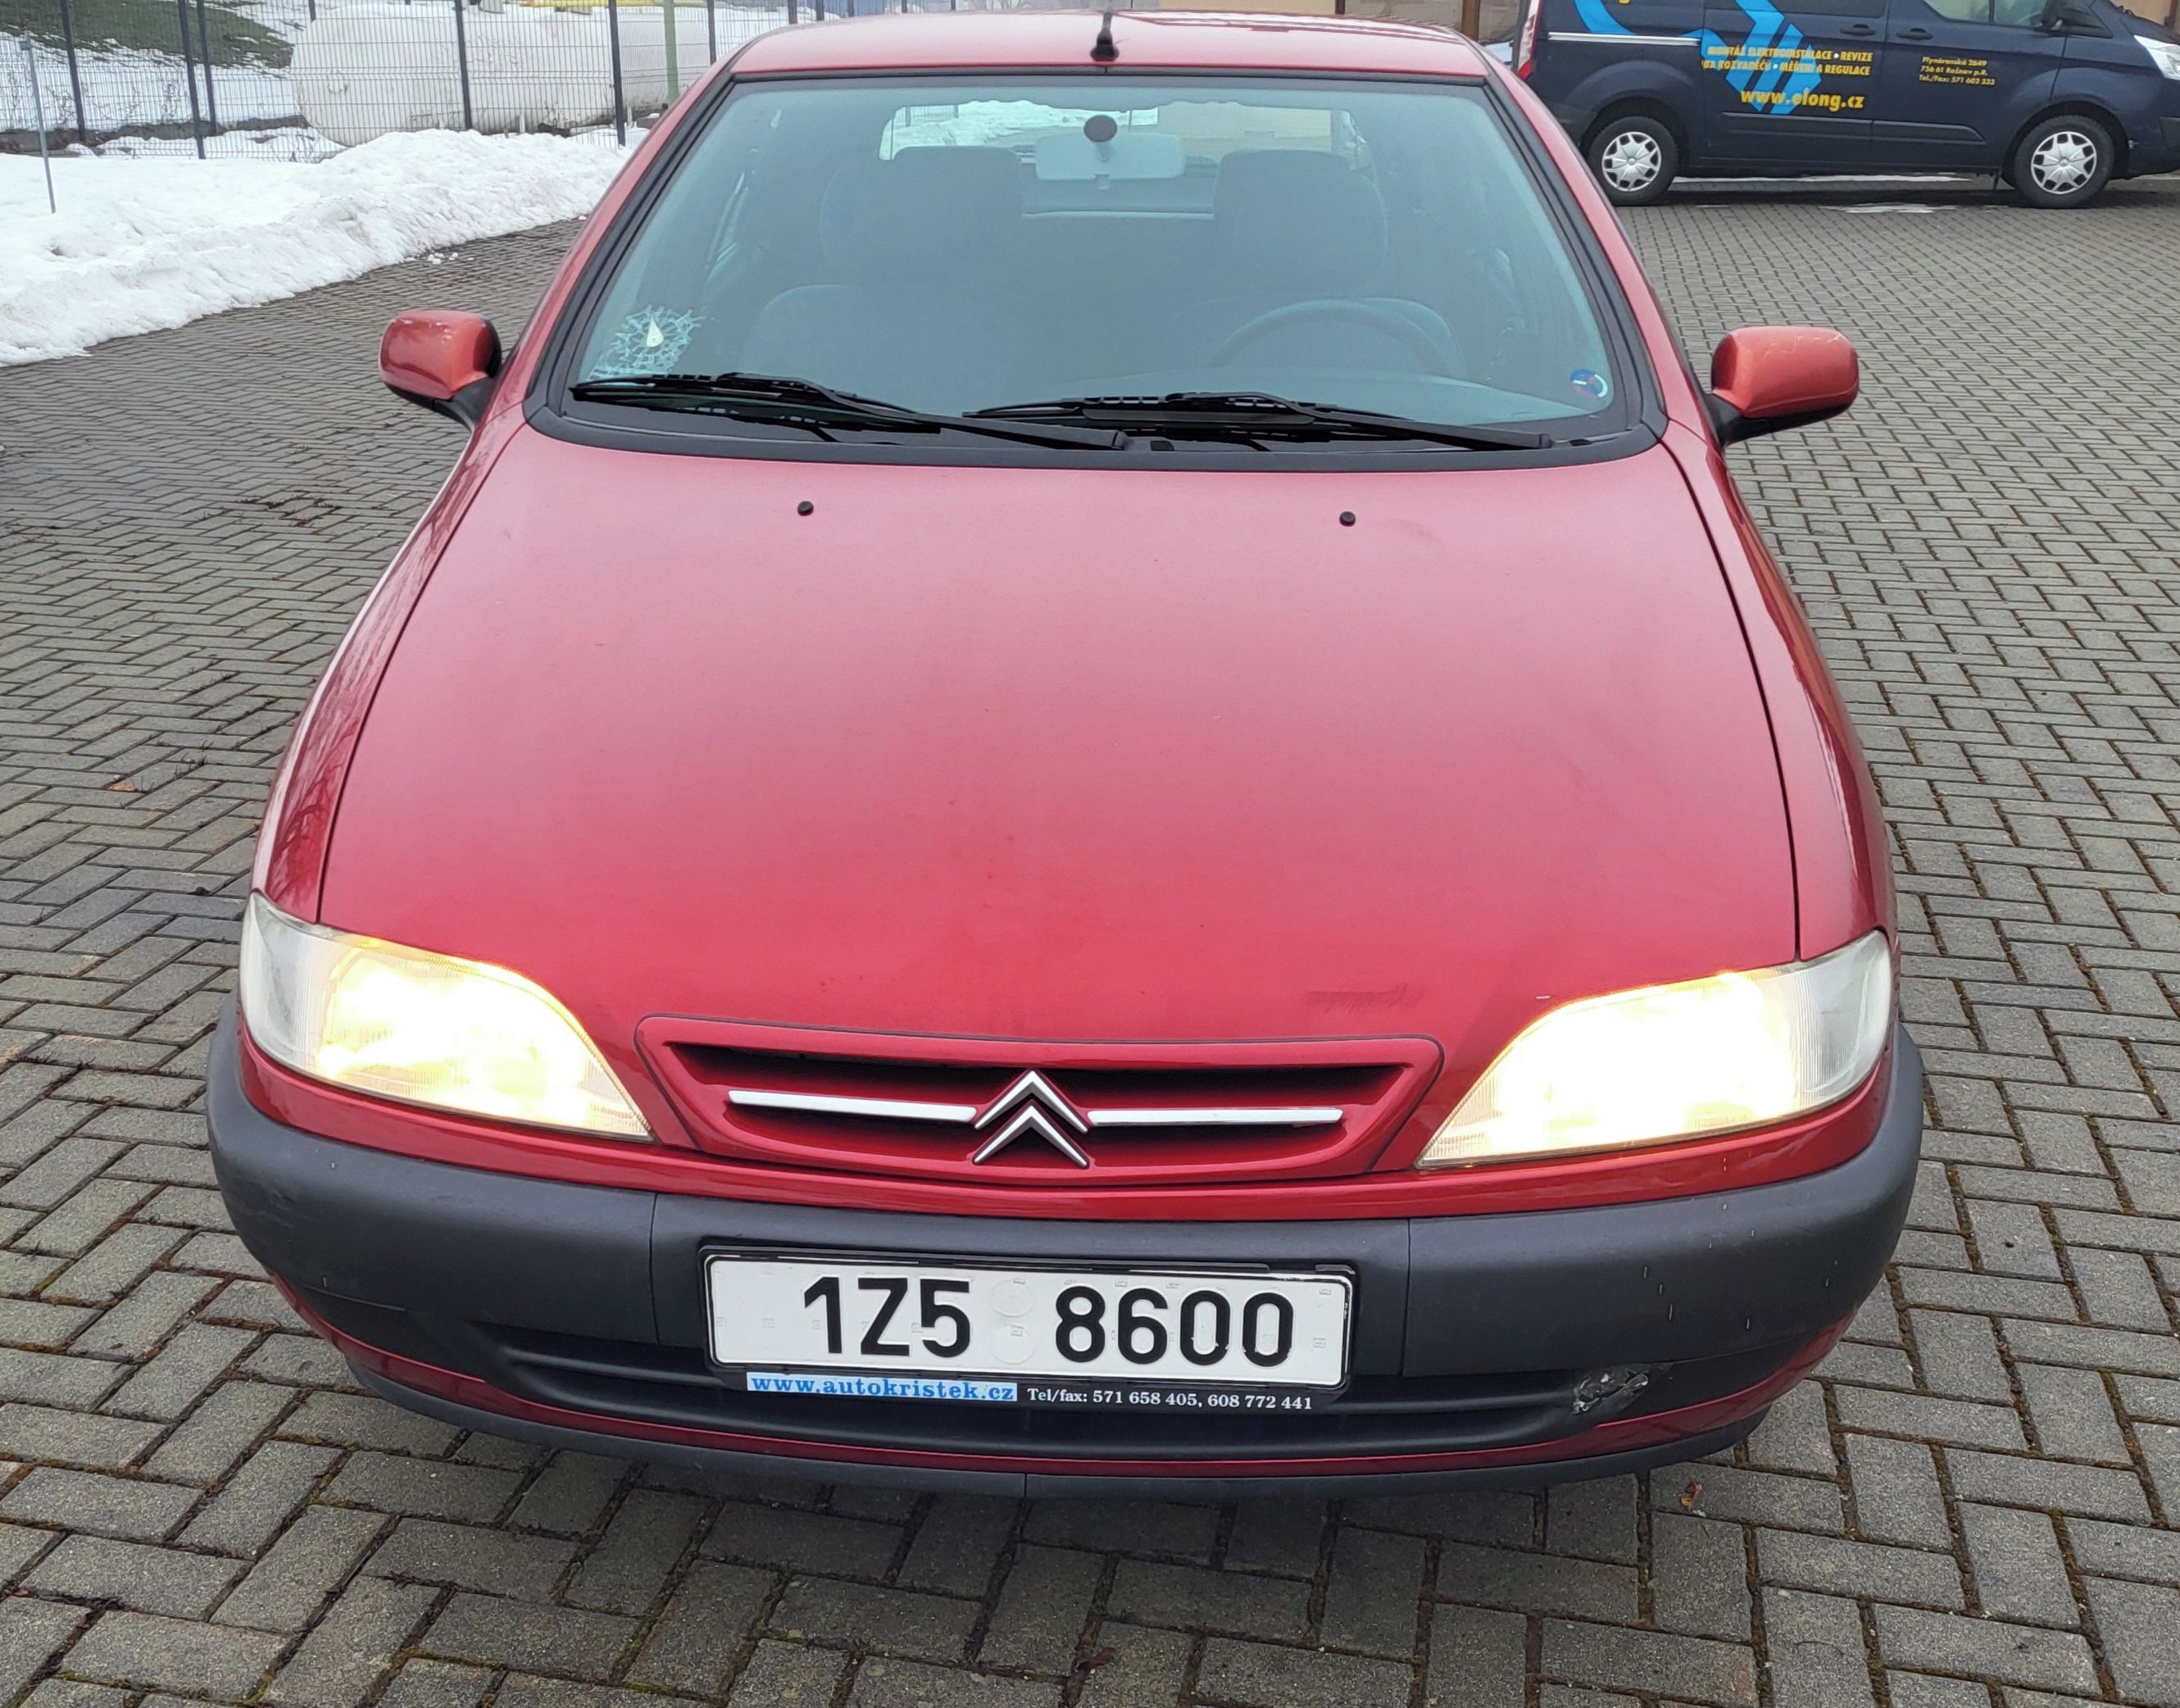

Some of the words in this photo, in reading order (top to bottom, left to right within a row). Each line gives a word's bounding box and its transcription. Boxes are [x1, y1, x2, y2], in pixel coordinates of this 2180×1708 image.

[1840, 51, 1873, 62] REVIZE
[1816, 64, 1823, 74] A
[1824, 64, 1871, 75] REGULACE
[1740, 88, 1865, 112] www.elong.cz
[803, 1276, 970, 1358] 1Z5
[1055, 1285, 1295, 1367] 8600
[751, 1377, 1015, 1401] www.autokristek.cz
[1027, 1388, 1088, 1403] Tel/fax:
[1092, 1390, 1124, 1404] 571
[1129, 1392, 1161, 1406] 658
[1165, 1392, 1203, 1408] 405,
[1207, 1394, 1240, 1408] 608
[1244, 1395, 1276, 1409] 772
[1280, 1396, 1313, 1410] 441
